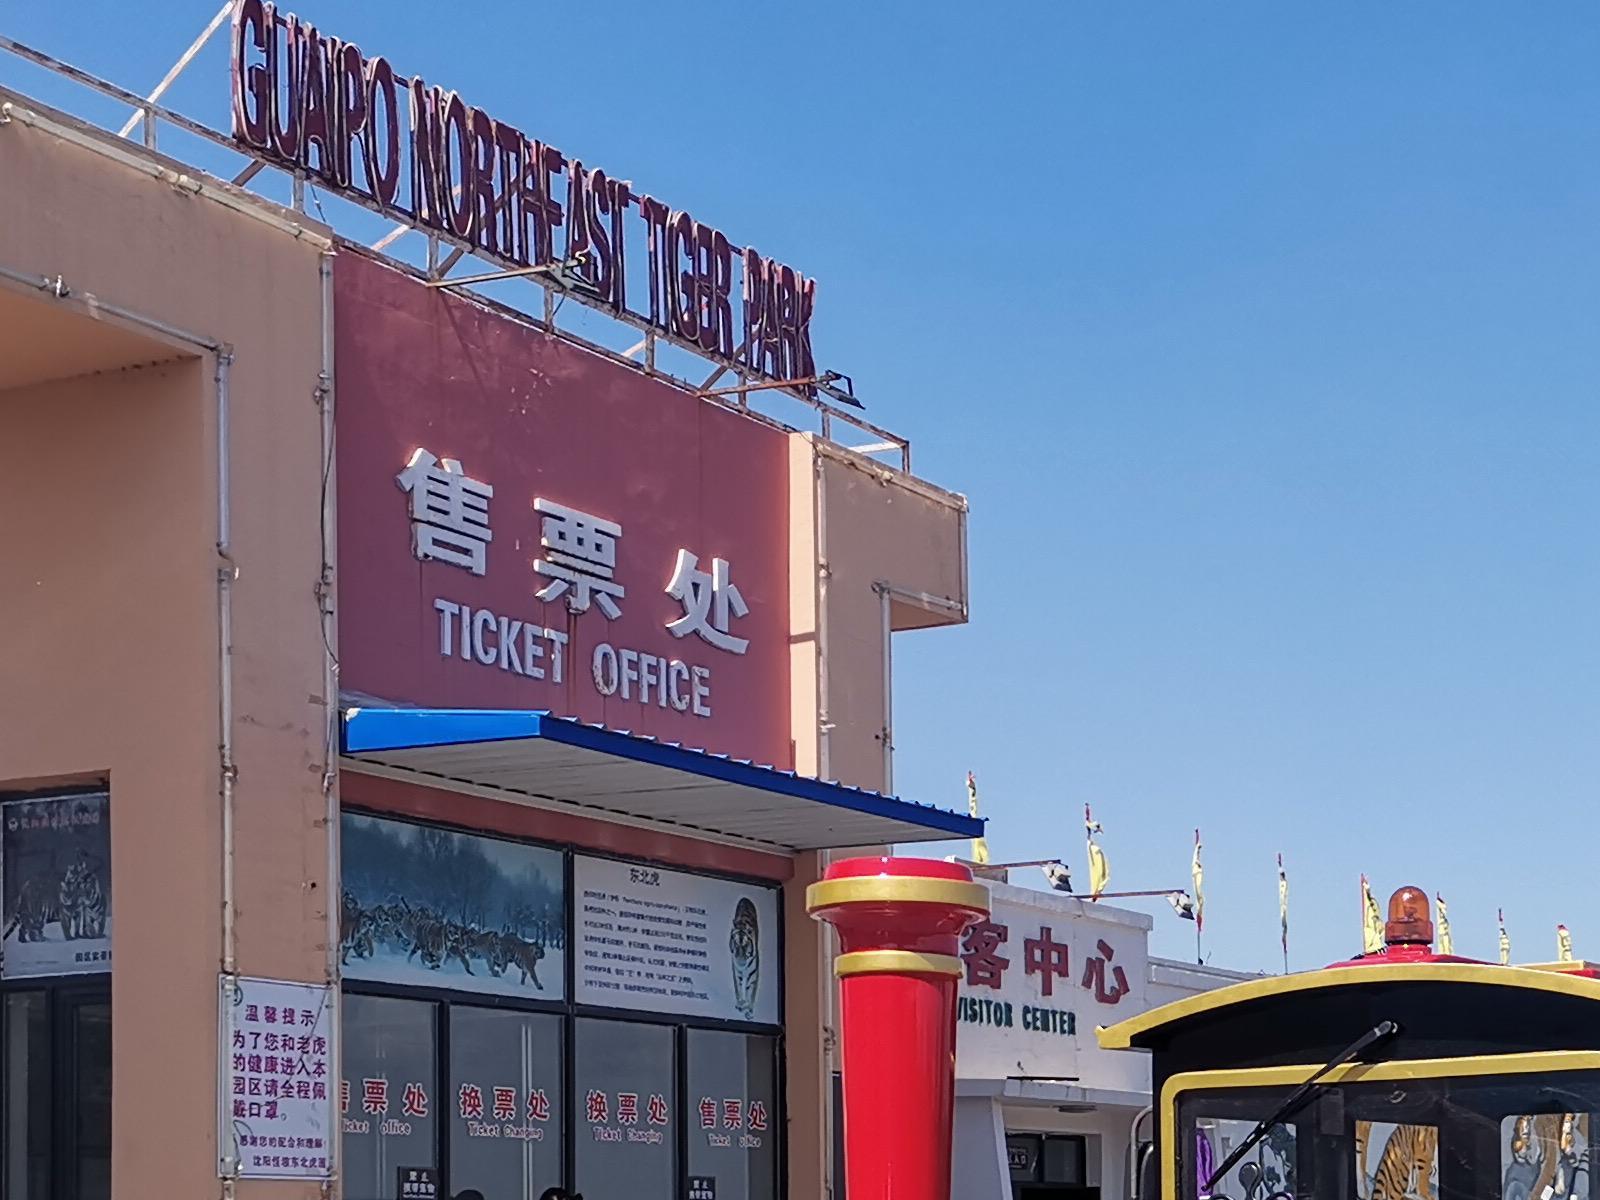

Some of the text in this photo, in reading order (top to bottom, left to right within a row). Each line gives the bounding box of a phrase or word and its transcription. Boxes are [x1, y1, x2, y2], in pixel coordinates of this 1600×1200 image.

[231, 0, 817, 397] GUAIPO NORTHEAST TIGER PARK
[396, 447, 750, 655] 售票处
[434, 598, 711, 717] TICKET OFFICE
[245, 1004, 315, 1027] 温馨提示
[1022, 1004, 1077, 1036] CENTER
[232, 1029, 326, 1056] 为了您和老虎
[232, 1054, 326, 1079] 的健康进入本
[232, 1075, 326, 1100] 园区请全程佩
[459, 1083, 550, 1121] 换票处
[232, 1098, 287, 1121] 戴口罩。
[587, 1089, 668, 1125] 换票处
[700, 1097, 768, 1130] 售票处
[467, 1121, 499, 1137] Ticket
